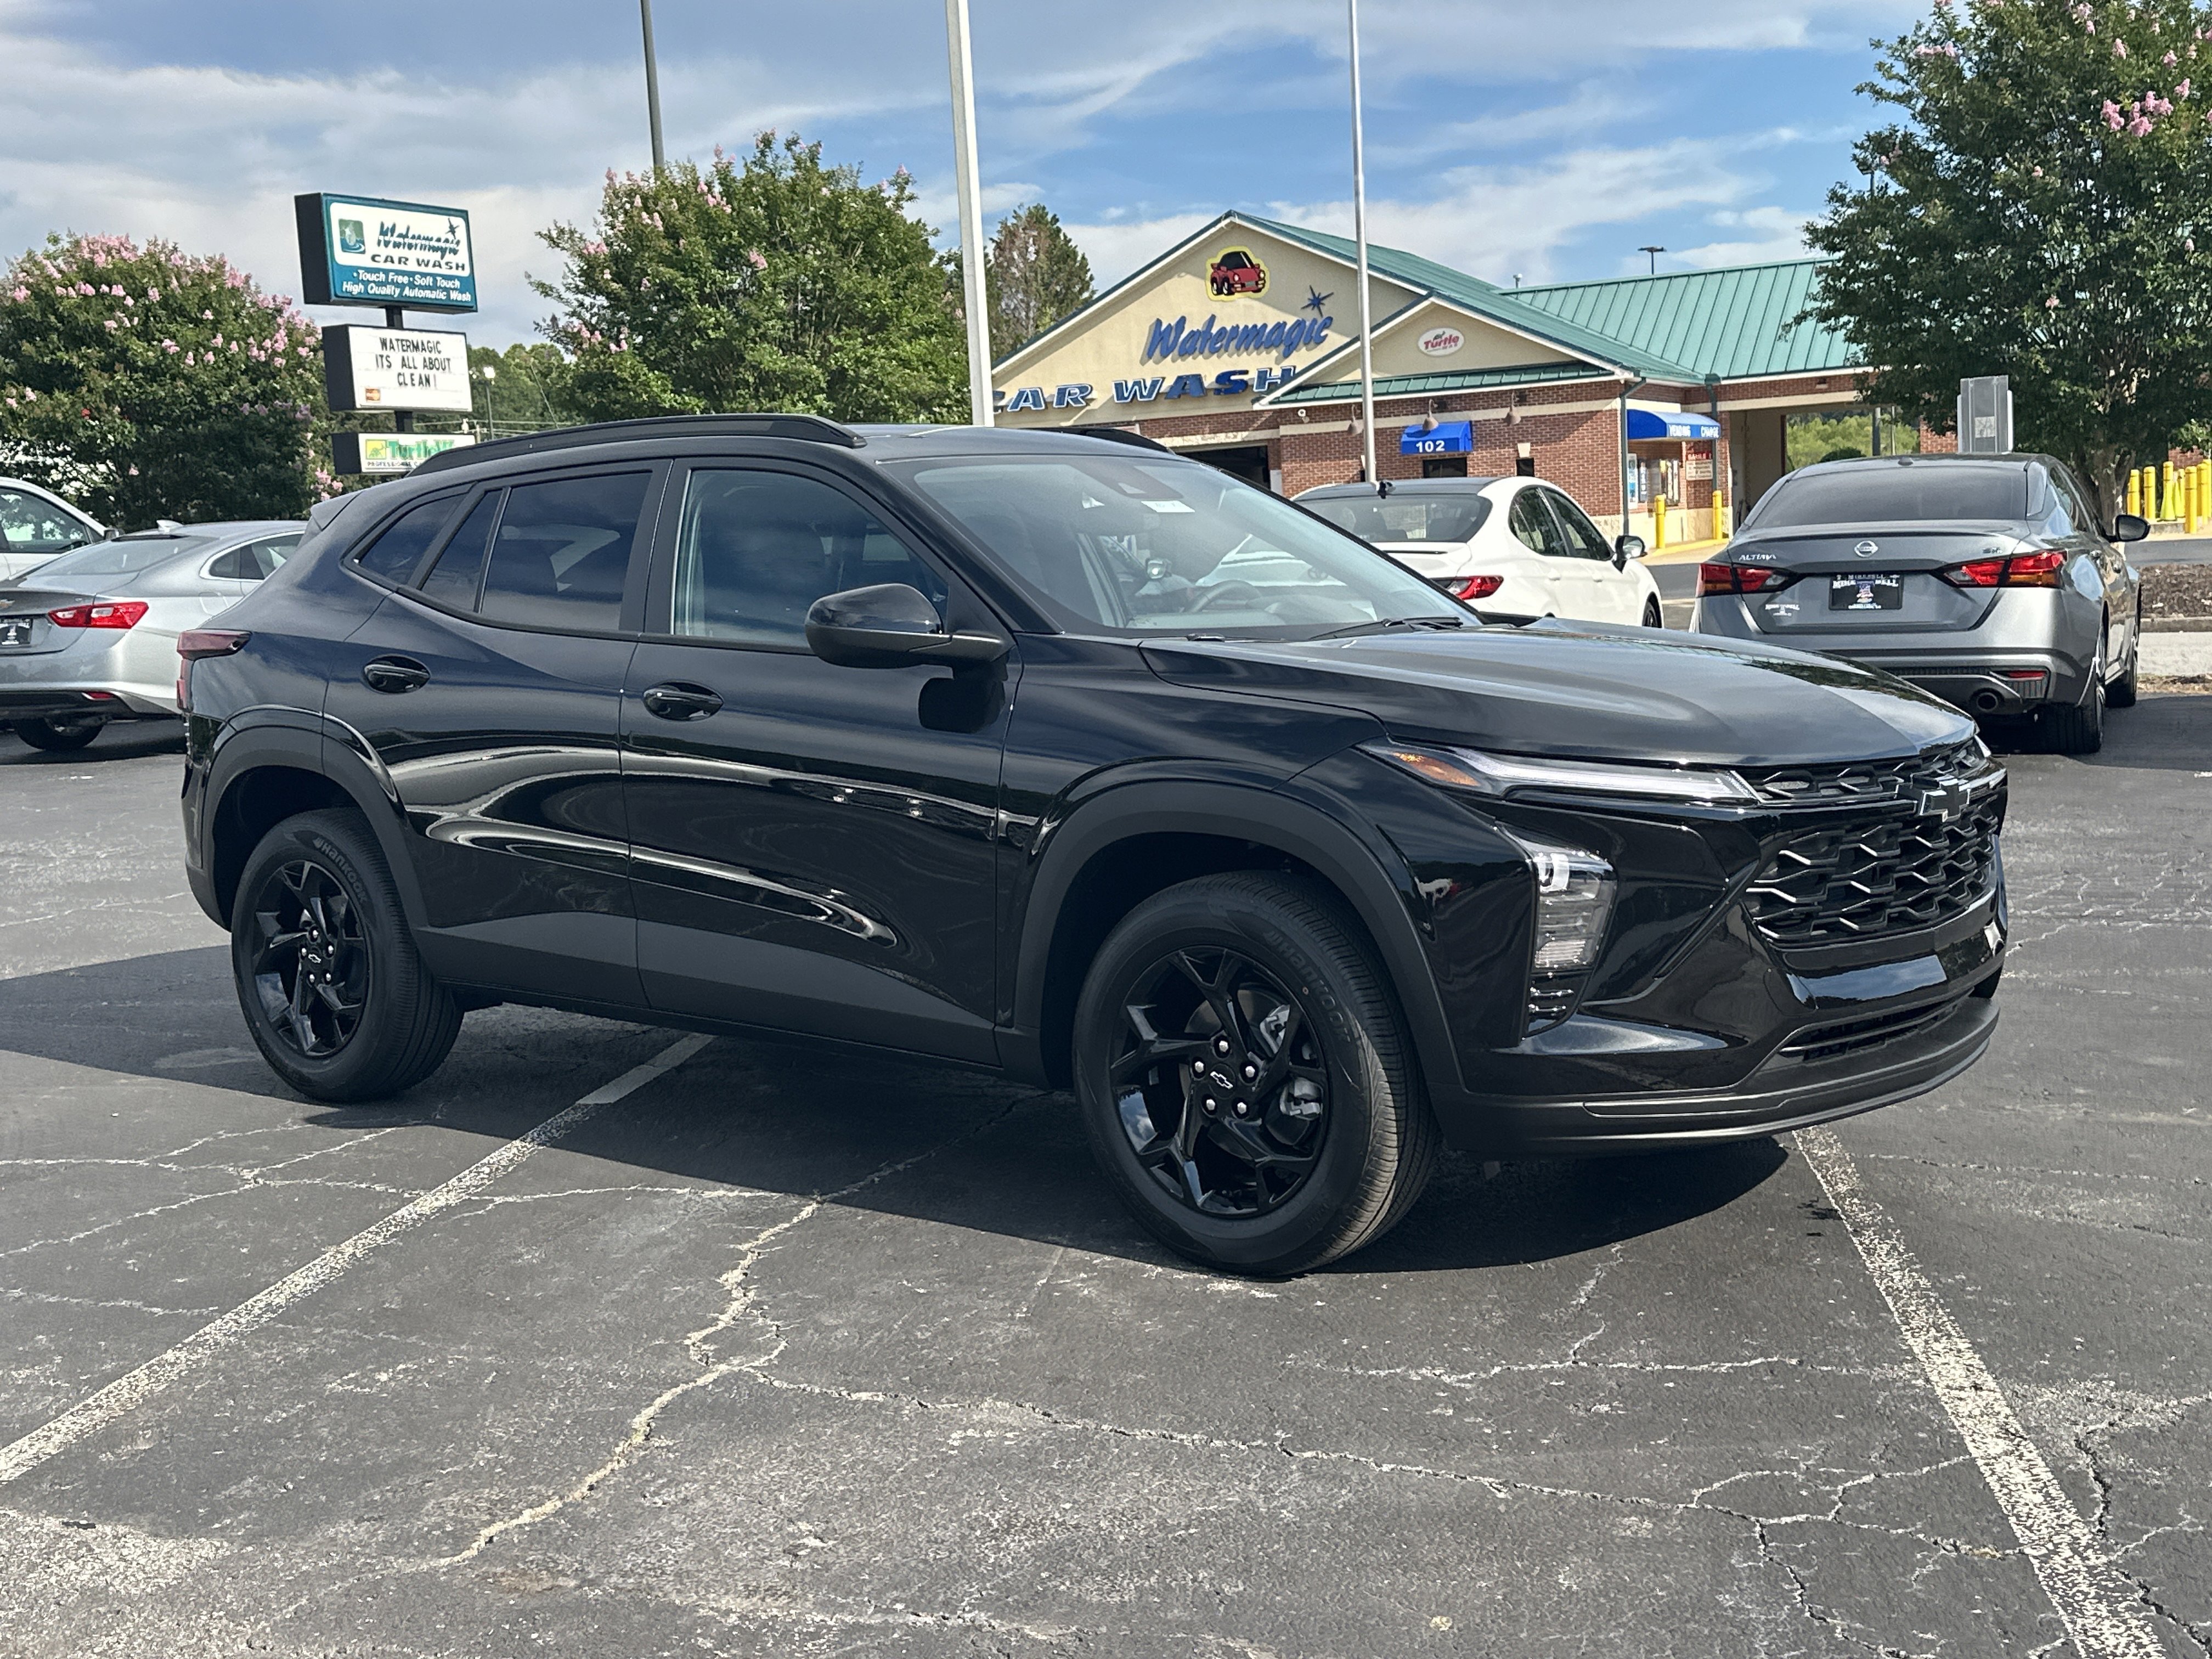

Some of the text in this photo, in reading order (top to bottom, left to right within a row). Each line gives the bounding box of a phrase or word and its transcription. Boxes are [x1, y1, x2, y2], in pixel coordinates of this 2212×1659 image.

[377, 221, 460, 261] Watermagic
[371, 254, 465, 272] CAR WASH
[357, 269, 460, 289] Touch Free Soft Touch
[342, 281, 471, 302] High Quality Automatic Wash
[379, 337, 442, 354] WATERMAGIC
[1147, 314, 1333, 358] Watermagic
[1424, 334, 1459, 350] Turtle
[375, 354, 452, 373] ITS ALL ABOUT
[1113, 365, 1296, 403] WASH
[1416, 440, 1445, 453] 102
